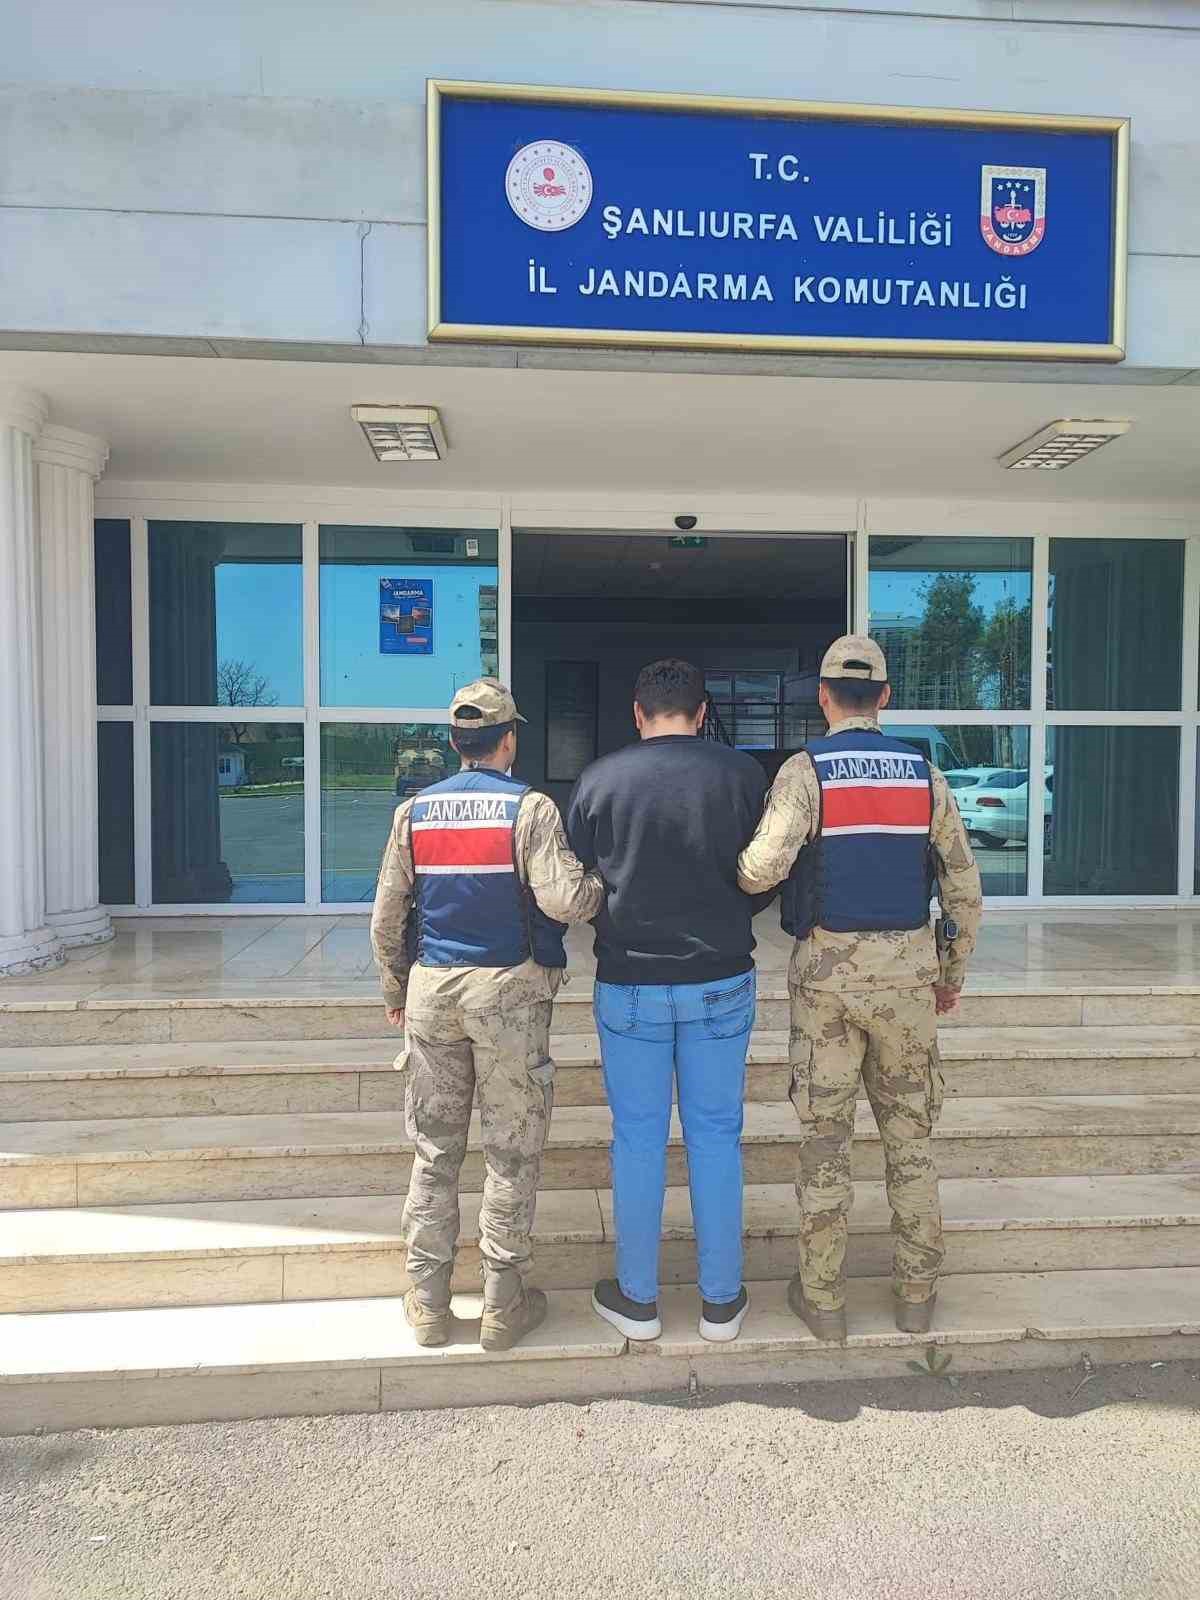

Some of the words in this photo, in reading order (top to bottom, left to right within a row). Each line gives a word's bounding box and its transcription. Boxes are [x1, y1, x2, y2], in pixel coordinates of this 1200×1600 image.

[749, 153, 810, 184] T.C.
[601, 205, 798, 242] ŞANLIURFA
[814, 212, 952, 247] VALİLİĞİ
[982, 225, 1043, 254] JANDARMA
[527, 258, 557, 294] İL
[579, 268, 774, 302] JANDARMA
[794, 274, 1027, 310] KOMUTANLIĞI
[827, 758, 917, 780] JANDARMA
[422, 799, 507, 821] JANDARMA
